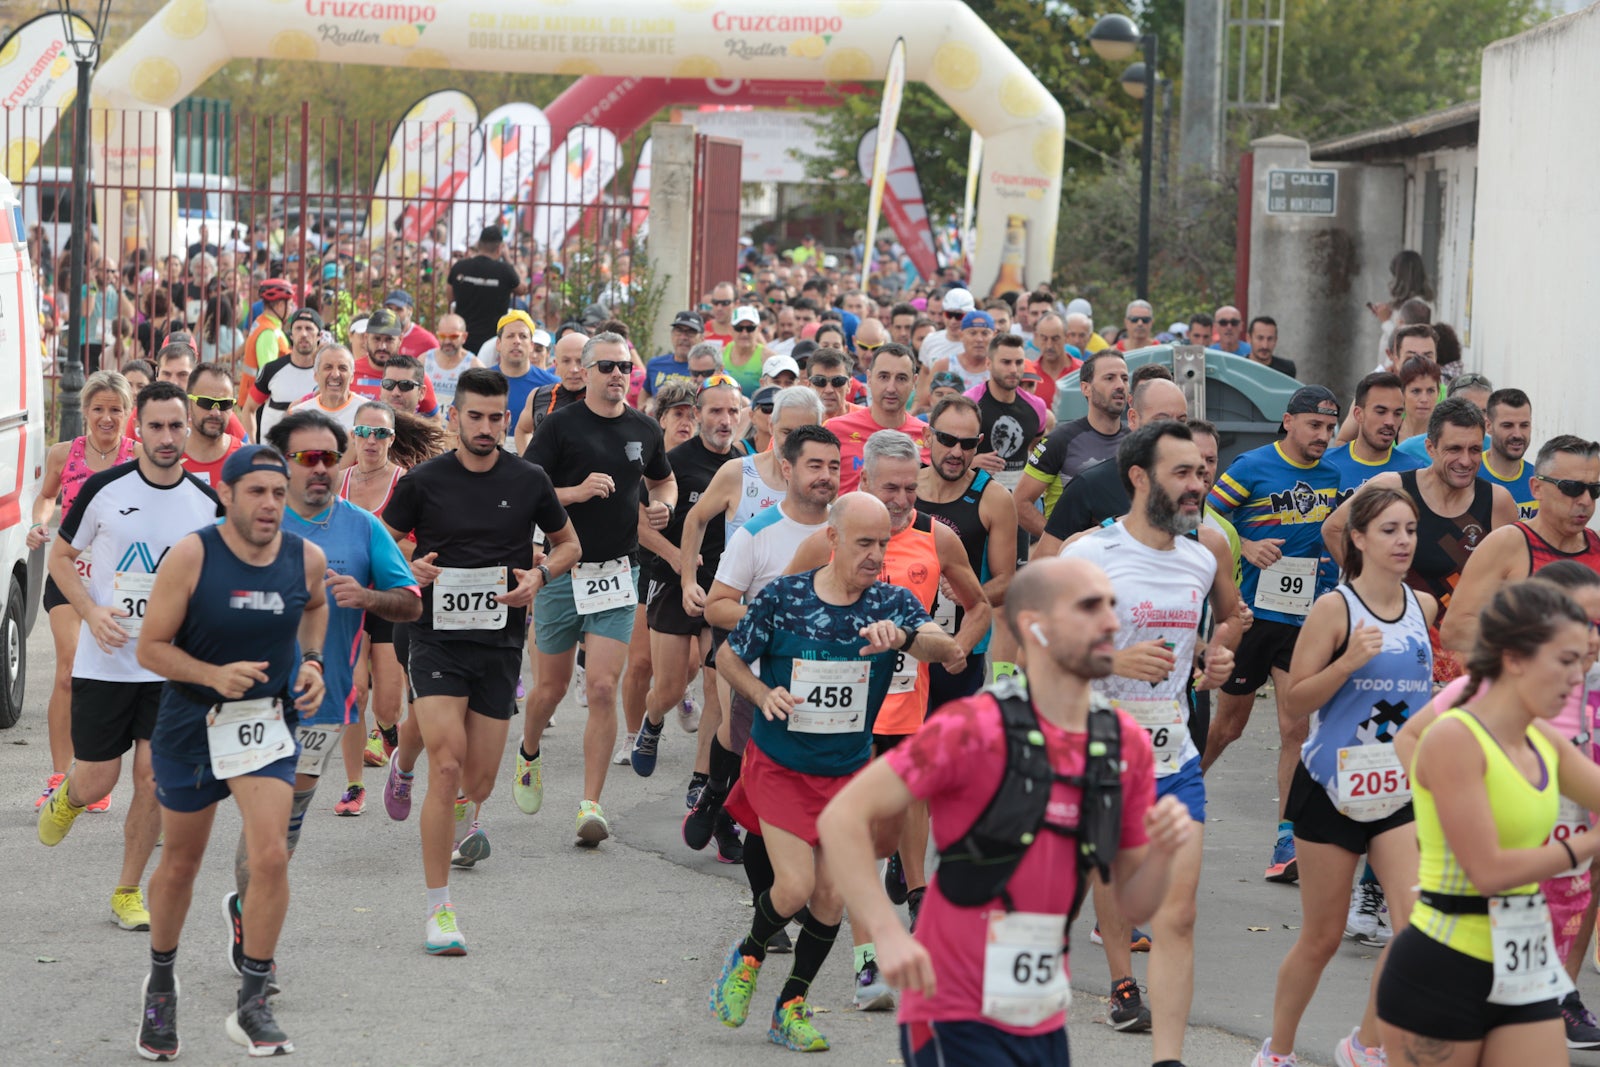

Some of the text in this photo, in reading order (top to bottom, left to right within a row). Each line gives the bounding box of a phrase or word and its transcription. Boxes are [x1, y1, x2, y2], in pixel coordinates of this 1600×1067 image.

[305, 0, 436, 23] Cruzcampo
[711, 11, 842, 34] Cruzcampo
[317, 23, 380, 47] Radler
[468, 32, 676, 55] DOBLEMENTE REFRESCANTE
[724, 38, 787, 60] Radler
[1291, 174, 1330, 186] CALLE
[586, 575, 620, 595] 201
[1280, 576, 1303, 594] 99
[229, 590, 285, 611] FILA
[442, 591, 499, 612] 3078
[1353, 679, 1428, 692] TODO SUMA
[807, 686, 853, 708] 458
[238, 722, 264, 746] 60
